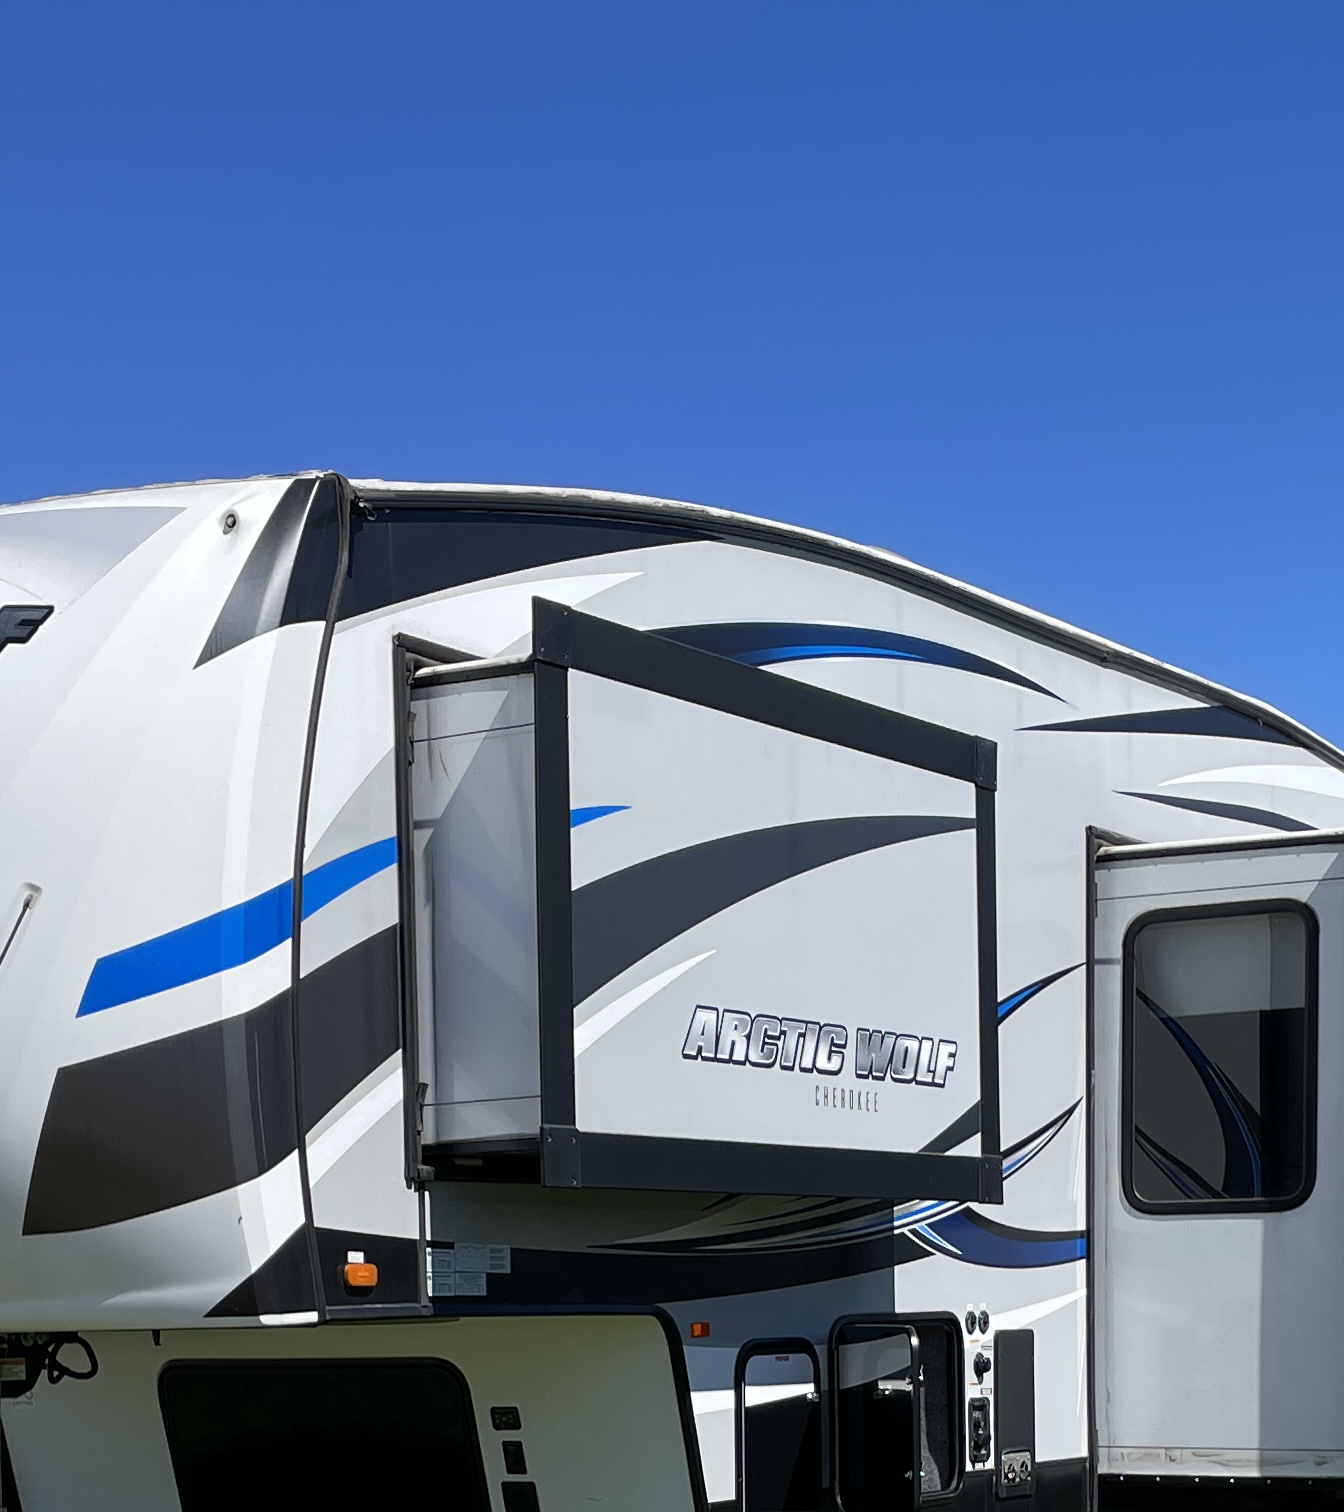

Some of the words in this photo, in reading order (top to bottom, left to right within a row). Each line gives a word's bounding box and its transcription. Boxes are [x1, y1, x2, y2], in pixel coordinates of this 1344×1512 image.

[682, 1004, 847, 1075] ARCTIC
[855, 1027, 958, 1087] WOLF
[815, 1085, 878, 1112] CHEROKEE
